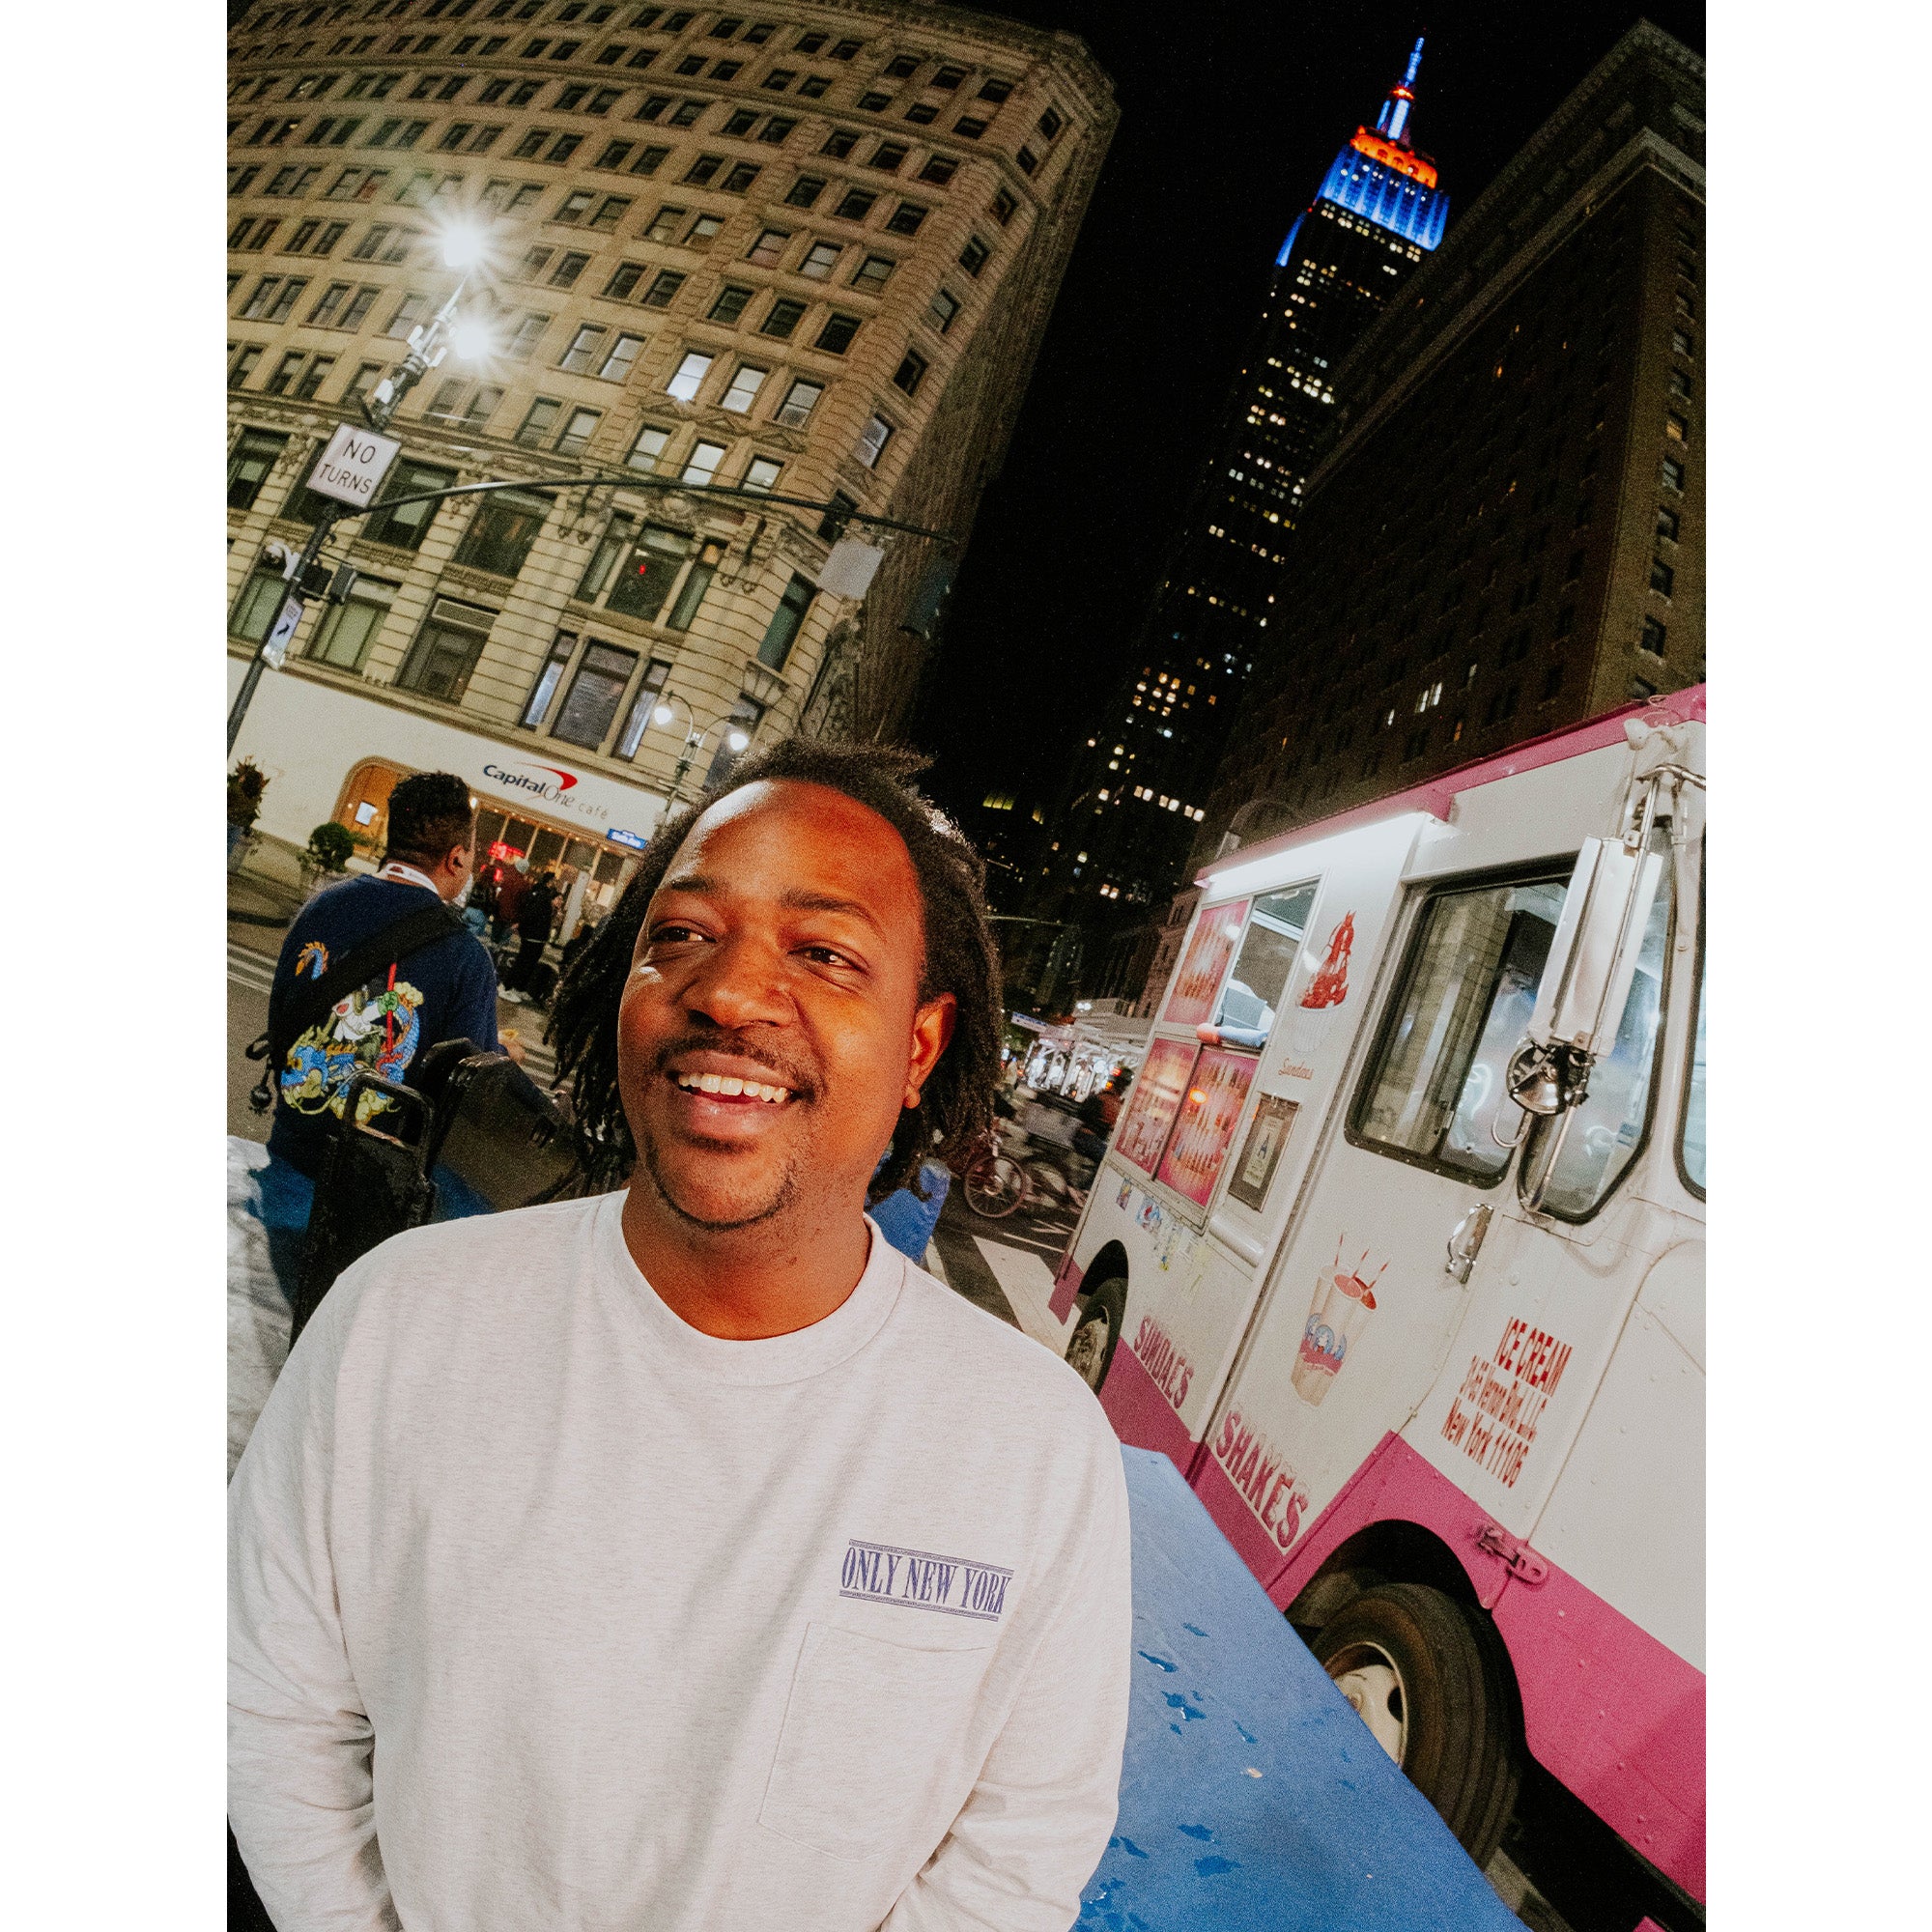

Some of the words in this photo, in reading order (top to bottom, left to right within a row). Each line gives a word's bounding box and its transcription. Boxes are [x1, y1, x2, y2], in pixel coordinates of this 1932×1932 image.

[320, 464, 372, 494] TURNS
[343, 440, 376, 464] NO
[483, 764, 546, 793] Capital
[543, 784, 575, 808] One
[1133, 1315, 1194, 1409] SUNDAES
[1493, 1316, 1527, 1371] ICE
[1516, 1327, 1573, 1397] CREAM
[1215, 1409, 1309, 1548] SHAKES
[1440, 1396, 1470, 1447] New
[1463, 1411, 1494, 1465] York
[1486, 1429, 1529, 1489] 11106
[841, 1547, 901, 1595] ONLY
[901, 1557, 959, 1605] NEW
[960, 1567, 1012, 1615] YORK
